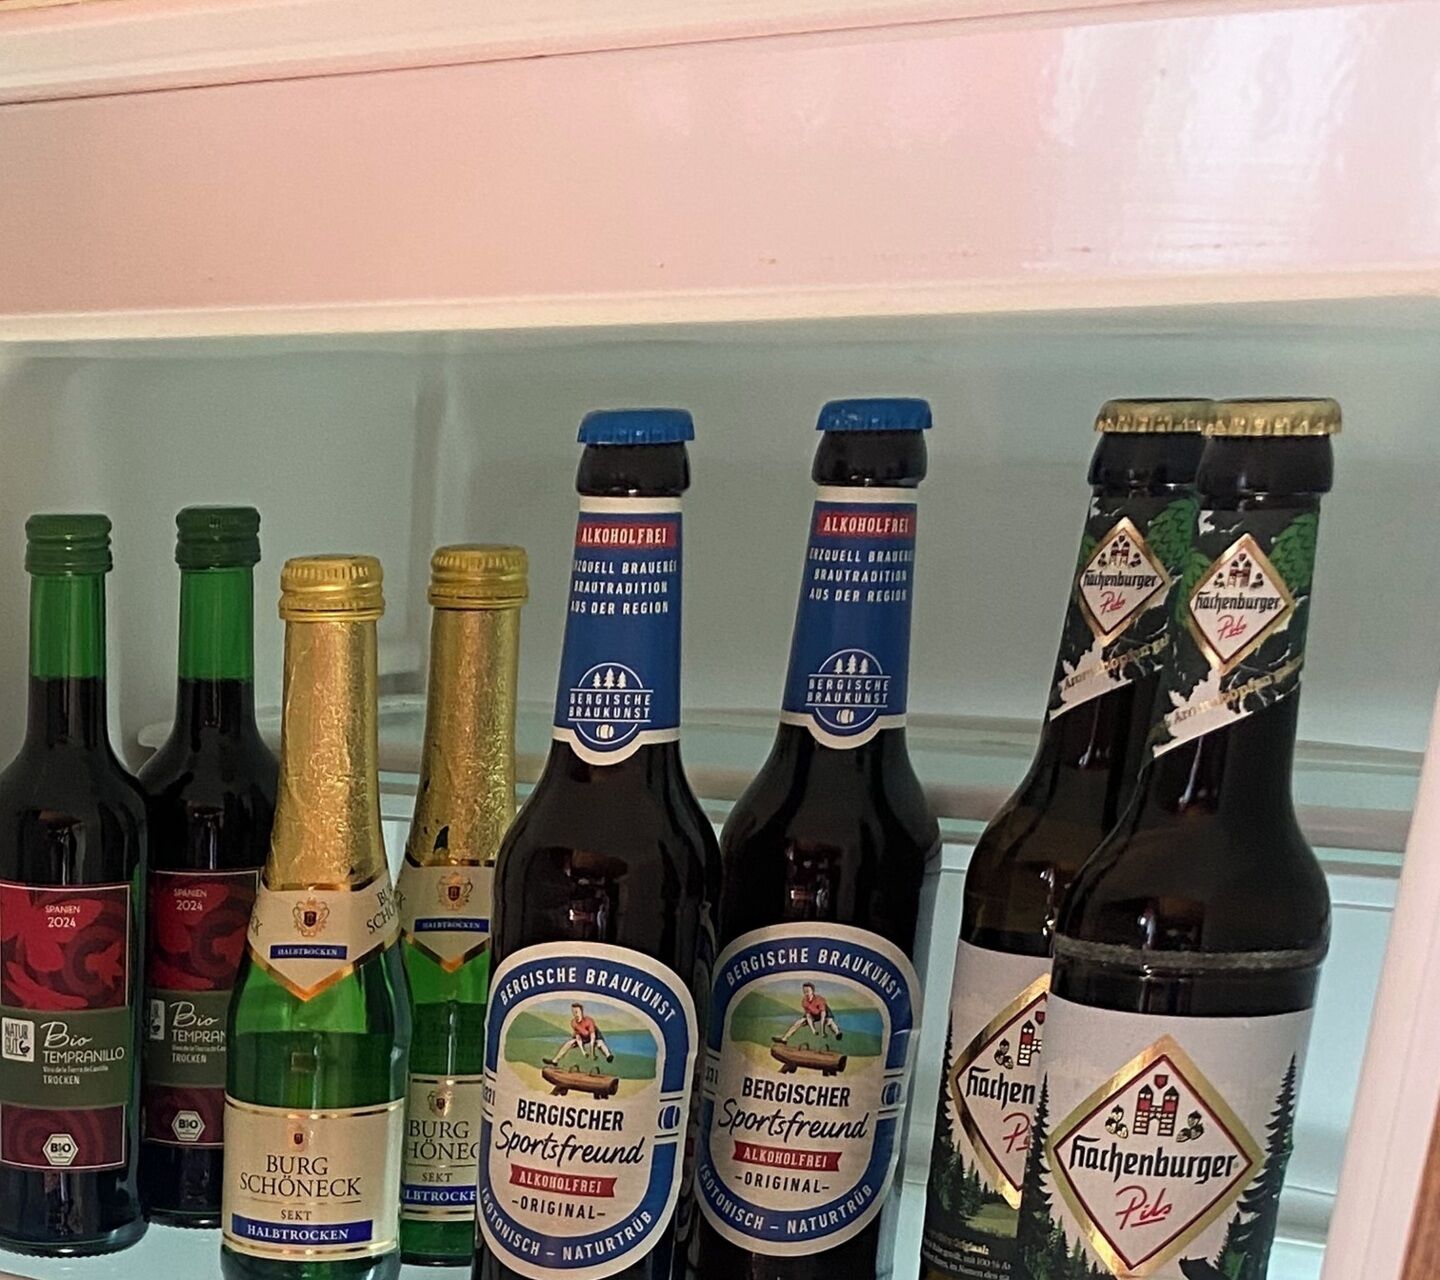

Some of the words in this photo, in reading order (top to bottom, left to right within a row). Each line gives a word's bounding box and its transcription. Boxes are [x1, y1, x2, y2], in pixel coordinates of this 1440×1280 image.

[823, 516, 910, 534] ALKOHOLFREI
[580, 527, 667, 545] ALKOHOLFREI
[621, 559, 677, 575] BRAUEREI
[813, 568, 907, 583] BRAUTRADITION
[573, 580, 668, 595] BRAUTRADITION
[808, 587, 830, 601] AUS
[834, 589, 860, 602] DER
[866, 589, 907, 603] REGION
[570, 600, 587, 614] AUS
[590, 601, 616, 615] DER
[622, 601, 669, 615] REGION
[1194, 591, 1280, 614] Hachenburger
[1216, 614, 1247, 639] Pils
[808, 678, 890, 692] BERGISCHE
[569, 692, 651, 706] BERGISCHE
[806, 691, 889, 705] BRAUKUNST
[568, 706, 651, 720] BRAUKUNST
[173, 888, 208, 899] SPANIEN
[44, 904, 81, 915] SPANIEN
[175, 899, 204, 912] 2024
[47, 916, 77, 929] 2024
[725, 947, 810, 988] BERGISCHE
[818, 949, 904, 1002] BRAUKUNST
[498, 966, 577, 1007] BERGISCHE
[585, 969, 677, 1023] BRAUKUNST
[169, 1000, 220, 1028] Bio
[39, 1020, 94, 1049] Bio
[42, 1045, 125, 1065] TEMPRANILLO
[172, 1052, 207, 1064] TROCKEN
[42, 1074, 81, 1085] TROCKEN
[742, 1076, 851, 1108] BERGISCHER
[516, 1097, 625, 1132] BERGISCHER
[717, 1097, 871, 1140] Sportsfreund
[410, 1120, 470, 1140] BURG
[494, 1120, 646, 1168] Sportsfreund
[265, 1154, 329, 1176] BURG
[743, 1148, 829, 1169] ALKOHOLFREI
[1069, 1133, 1238, 1186] Hachenburger
[239, 1171, 362, 1198] SCHÖNECK
[421, 1172, 454, 1183] SEKT
[518, 1171, 603, 1195] ALKOHOLFREI
[698, 1163, 764, 1231] ISOTONISCH
[787, 1183, 874, 1235] NATURTRÜB
[1114, 1184, 1174, 1231] Pils
[280, 1208, 313, 1222] SEKT
[480, 1187, 542, 1258] ISOTONISCH
[562, 1209, 654, 1262] NATURTRÜB
[246, 1223, 350, 1241] HALBTROCKEN
